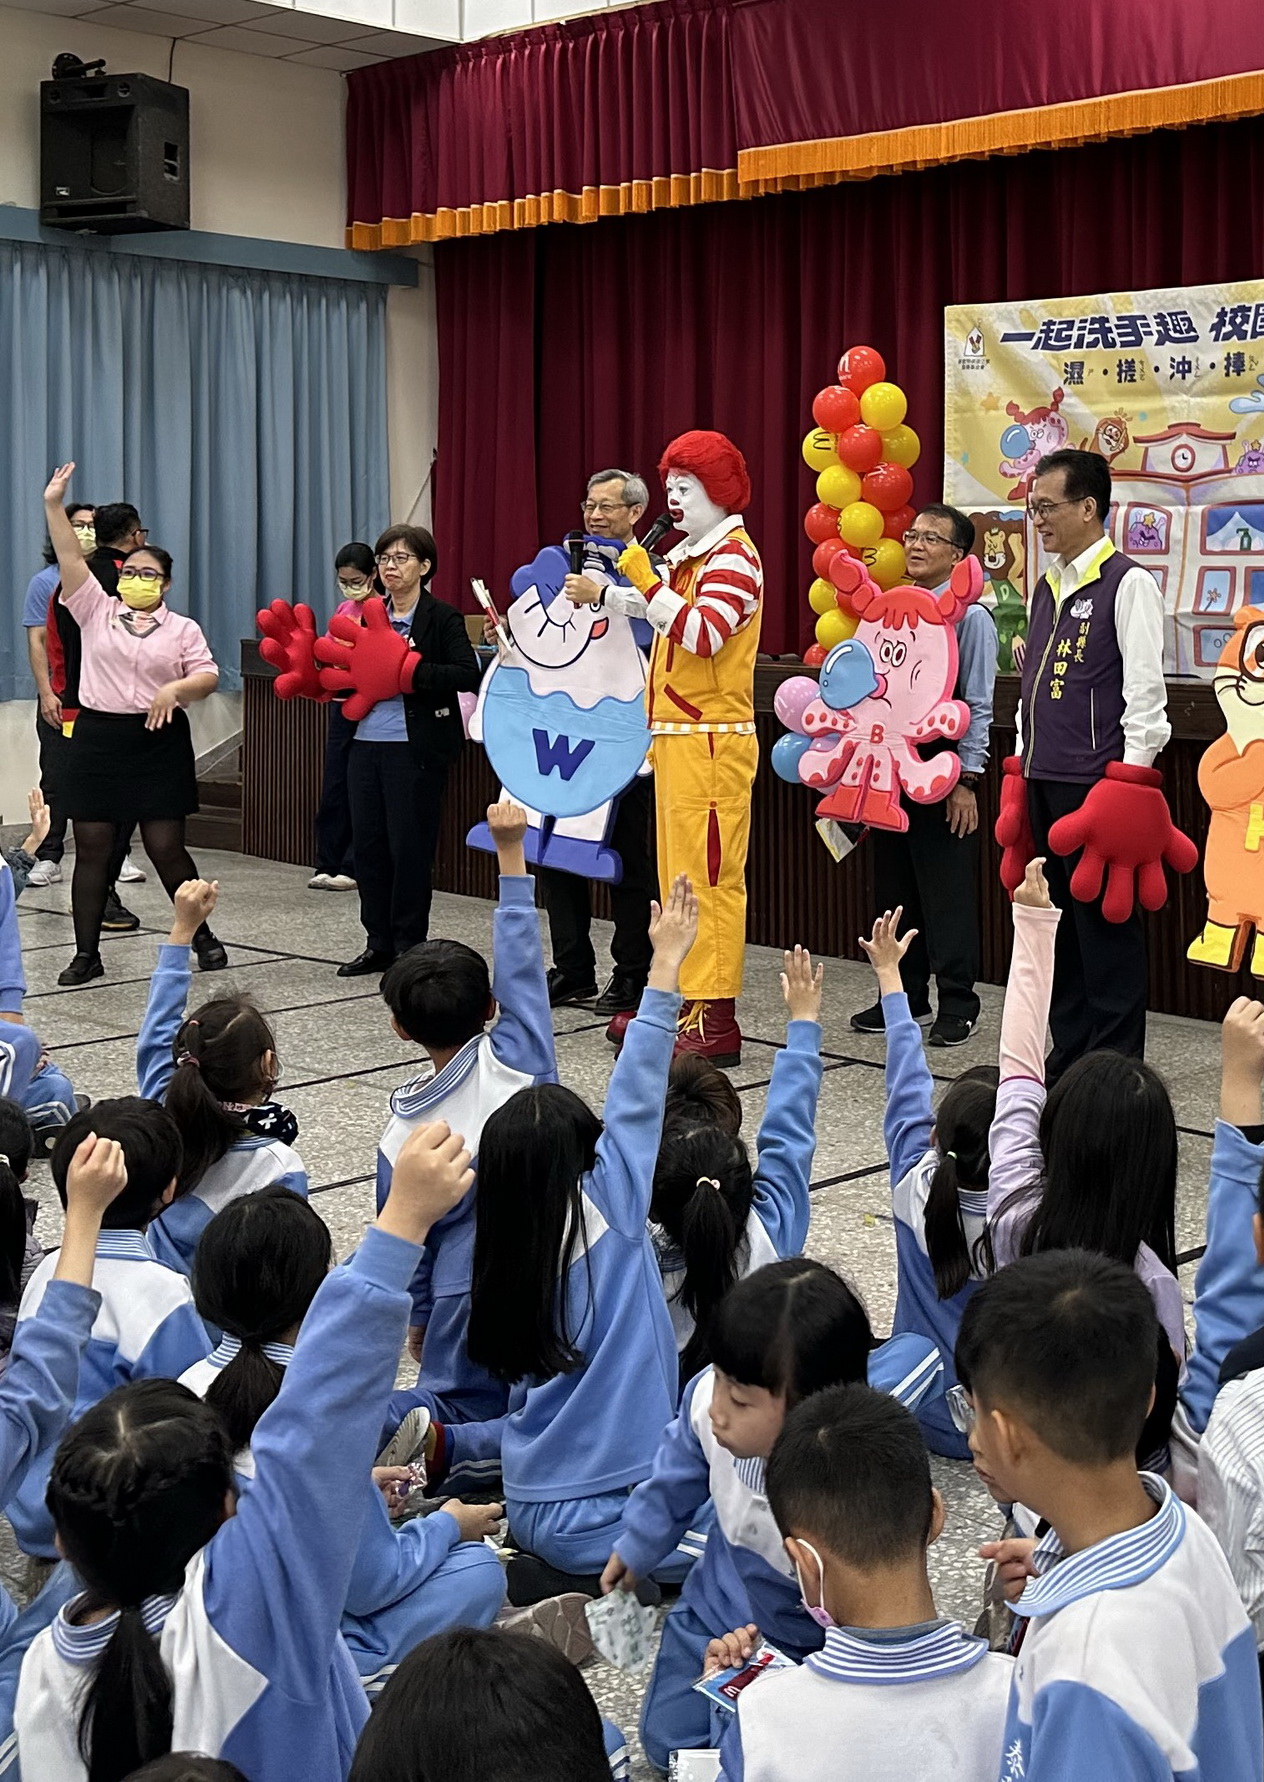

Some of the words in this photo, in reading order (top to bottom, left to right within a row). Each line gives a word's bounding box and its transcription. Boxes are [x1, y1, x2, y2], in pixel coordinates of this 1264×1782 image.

[1000, 310, 1199, 351] 一起洗手趣
[1050, 638, 1072, 700] 林田富
[532, 728, 596, 781] W
[870, 724, 884, 744] B
